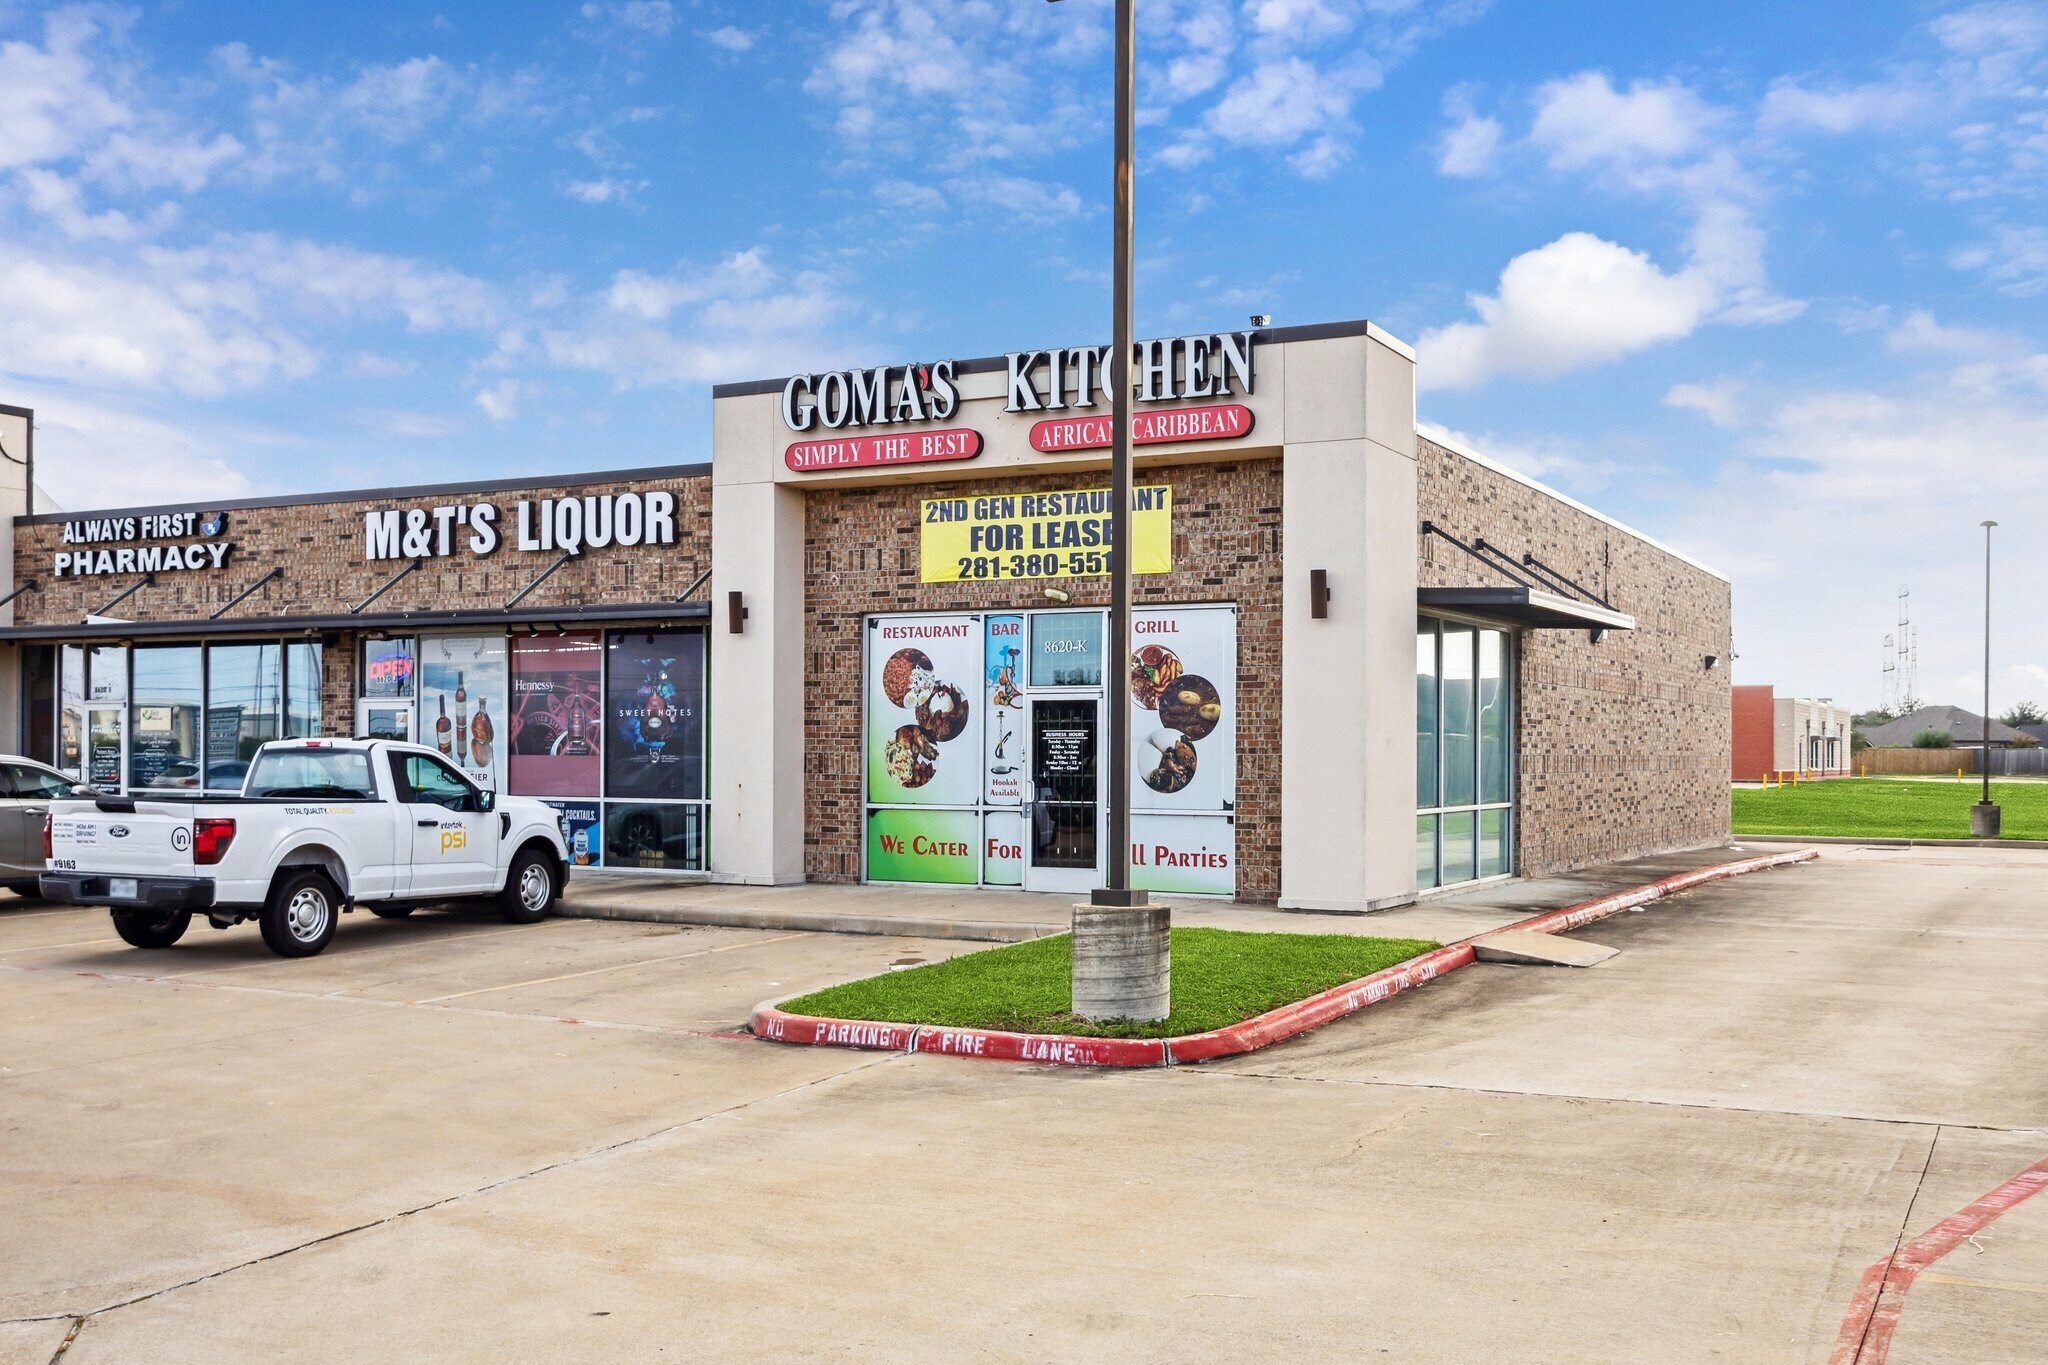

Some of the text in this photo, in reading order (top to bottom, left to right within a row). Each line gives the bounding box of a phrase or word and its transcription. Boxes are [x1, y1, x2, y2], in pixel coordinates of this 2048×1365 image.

[1132, 409, 1239, 440] CARIBBEAN
[793, 433, 969, 467] SIMPLY THE BEST
[925, 499, 968, 524] 2ND
[974, 496, 1015, 521] GEN
[62, 517, 136, 544] ALWAYS
[141, 512, 197, 539] FIRST
[365, 491, 676, 561] M&T'S LIQUOR
[970, 519, 1113, 553] FOR LEASE
[54, 542, 230, 577] PHARMACY
[958, 551, 1113, 579] 281-380-551
[883, 624, 970, 639] RESTAURANT
[991, 623, 1020, 636] BAR
[1134, 620, 1180, 634] GRILL
[1044, 639, 1088, 653] 8620-K
[369, 659, 412, 679] OPEN
[515, 679, 555, 692] Hennessy
[619, 708, 692, 717] SWEET NOTES
[284, 807, 303, 815] TOTAL
[441, 826, 467, 855] psi
[53, 859, 76, 870] #9163
[814, 1023, 892, 1047] PARKING
[941, 1032, 987, 1054] FIRE
[1021, 1038, 1077, 1063] LANE
